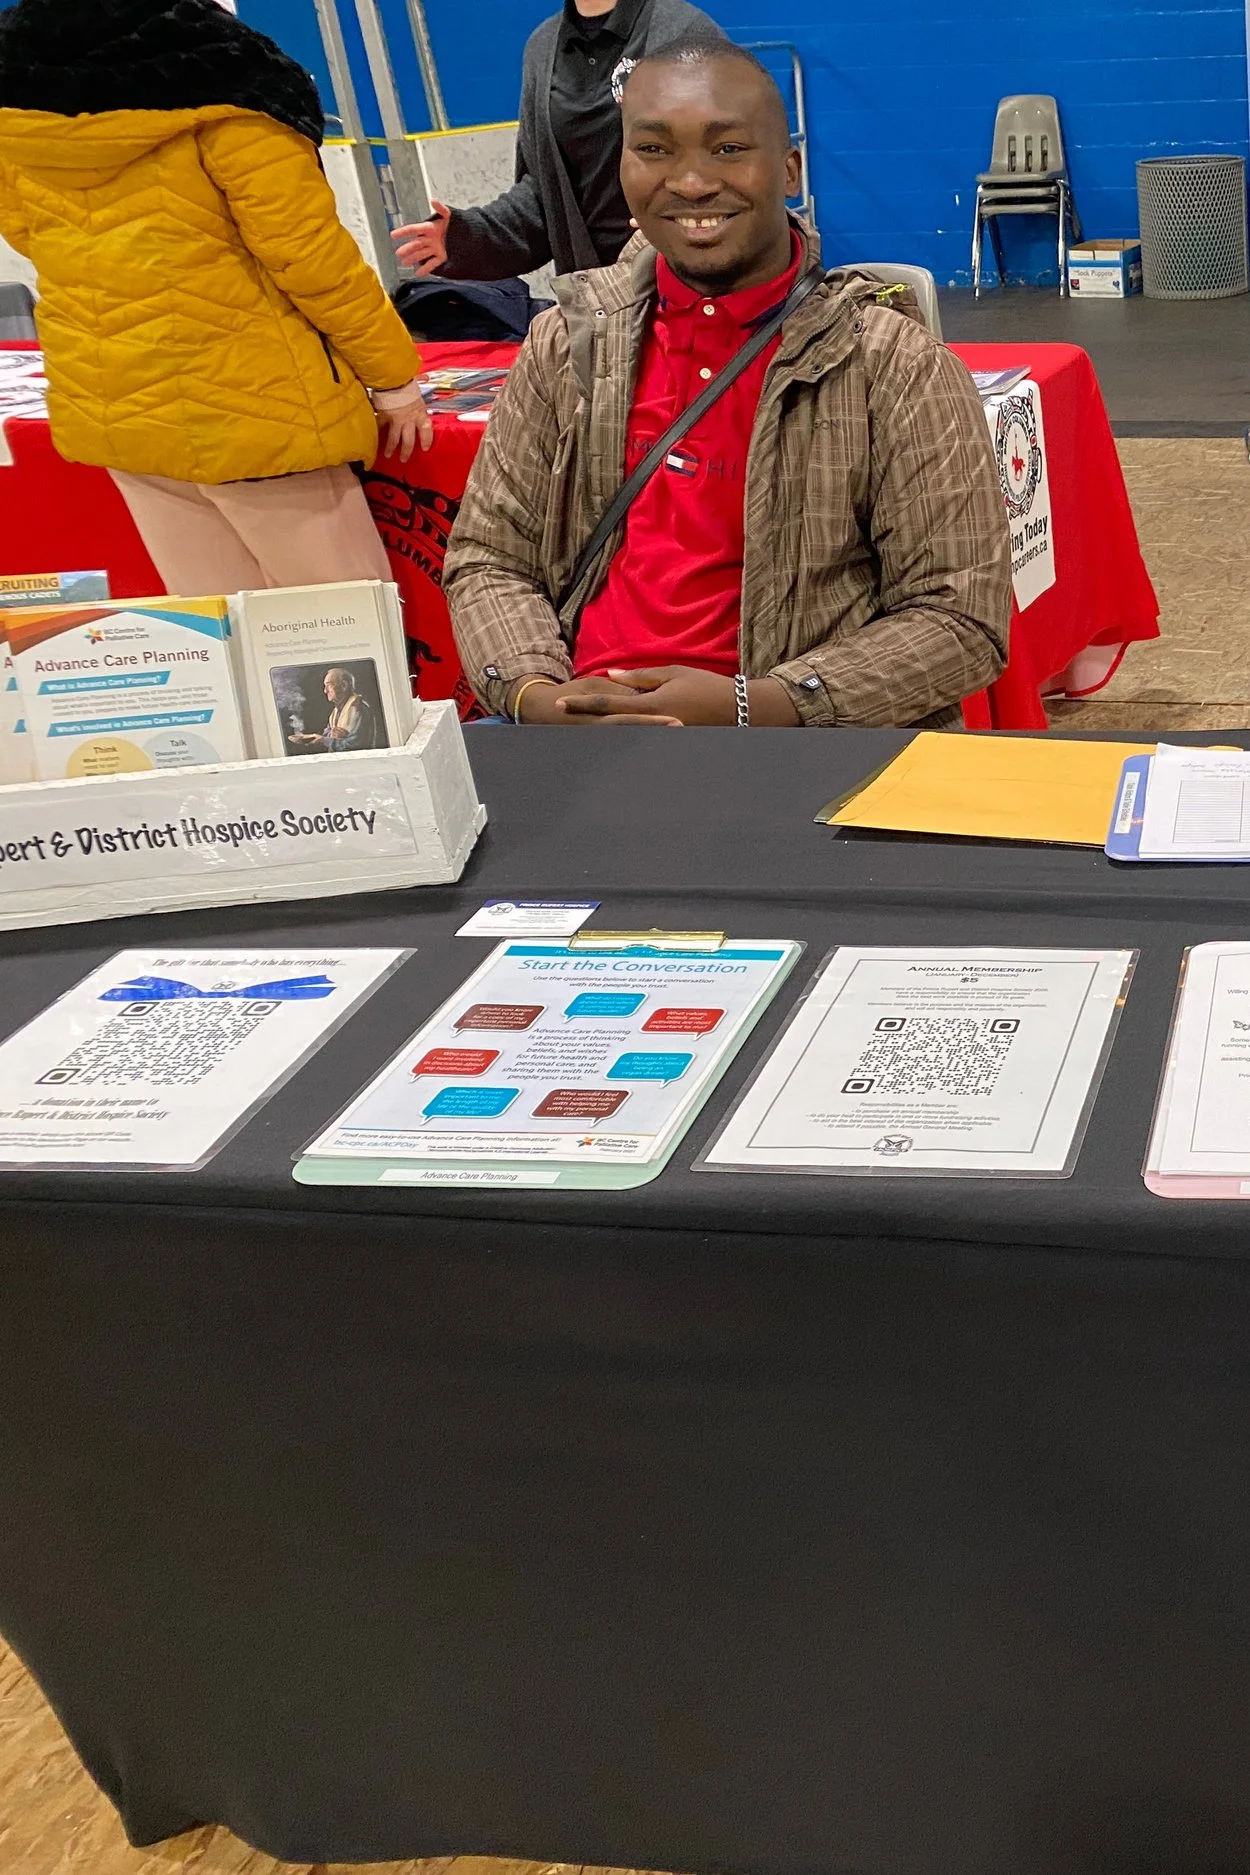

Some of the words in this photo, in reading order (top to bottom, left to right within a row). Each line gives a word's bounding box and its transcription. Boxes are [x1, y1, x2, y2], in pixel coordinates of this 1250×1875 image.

[1024, 515, 1048, 542] Today
[261, 619, 318, 633] Aboriginal
[320, 615, 356, 628] Health
[34, 659, 99, 672] Advance
[104, 654, 138, 667] Care
[143, 648, 210, 664] Planning
[170, 739, 186, 747] Talk
[51, 831, 73, 857] &
[75, 823, 177, 855] District
[180, 815, 279, 848] Hospice
[280, 807, 376, 837] Society
[518, 959, 569, 970] Start
[573, 960, 607, 971] the
[612, 961, 748, 974] Conversation
[480, 1172, 518, 1181] Planning
